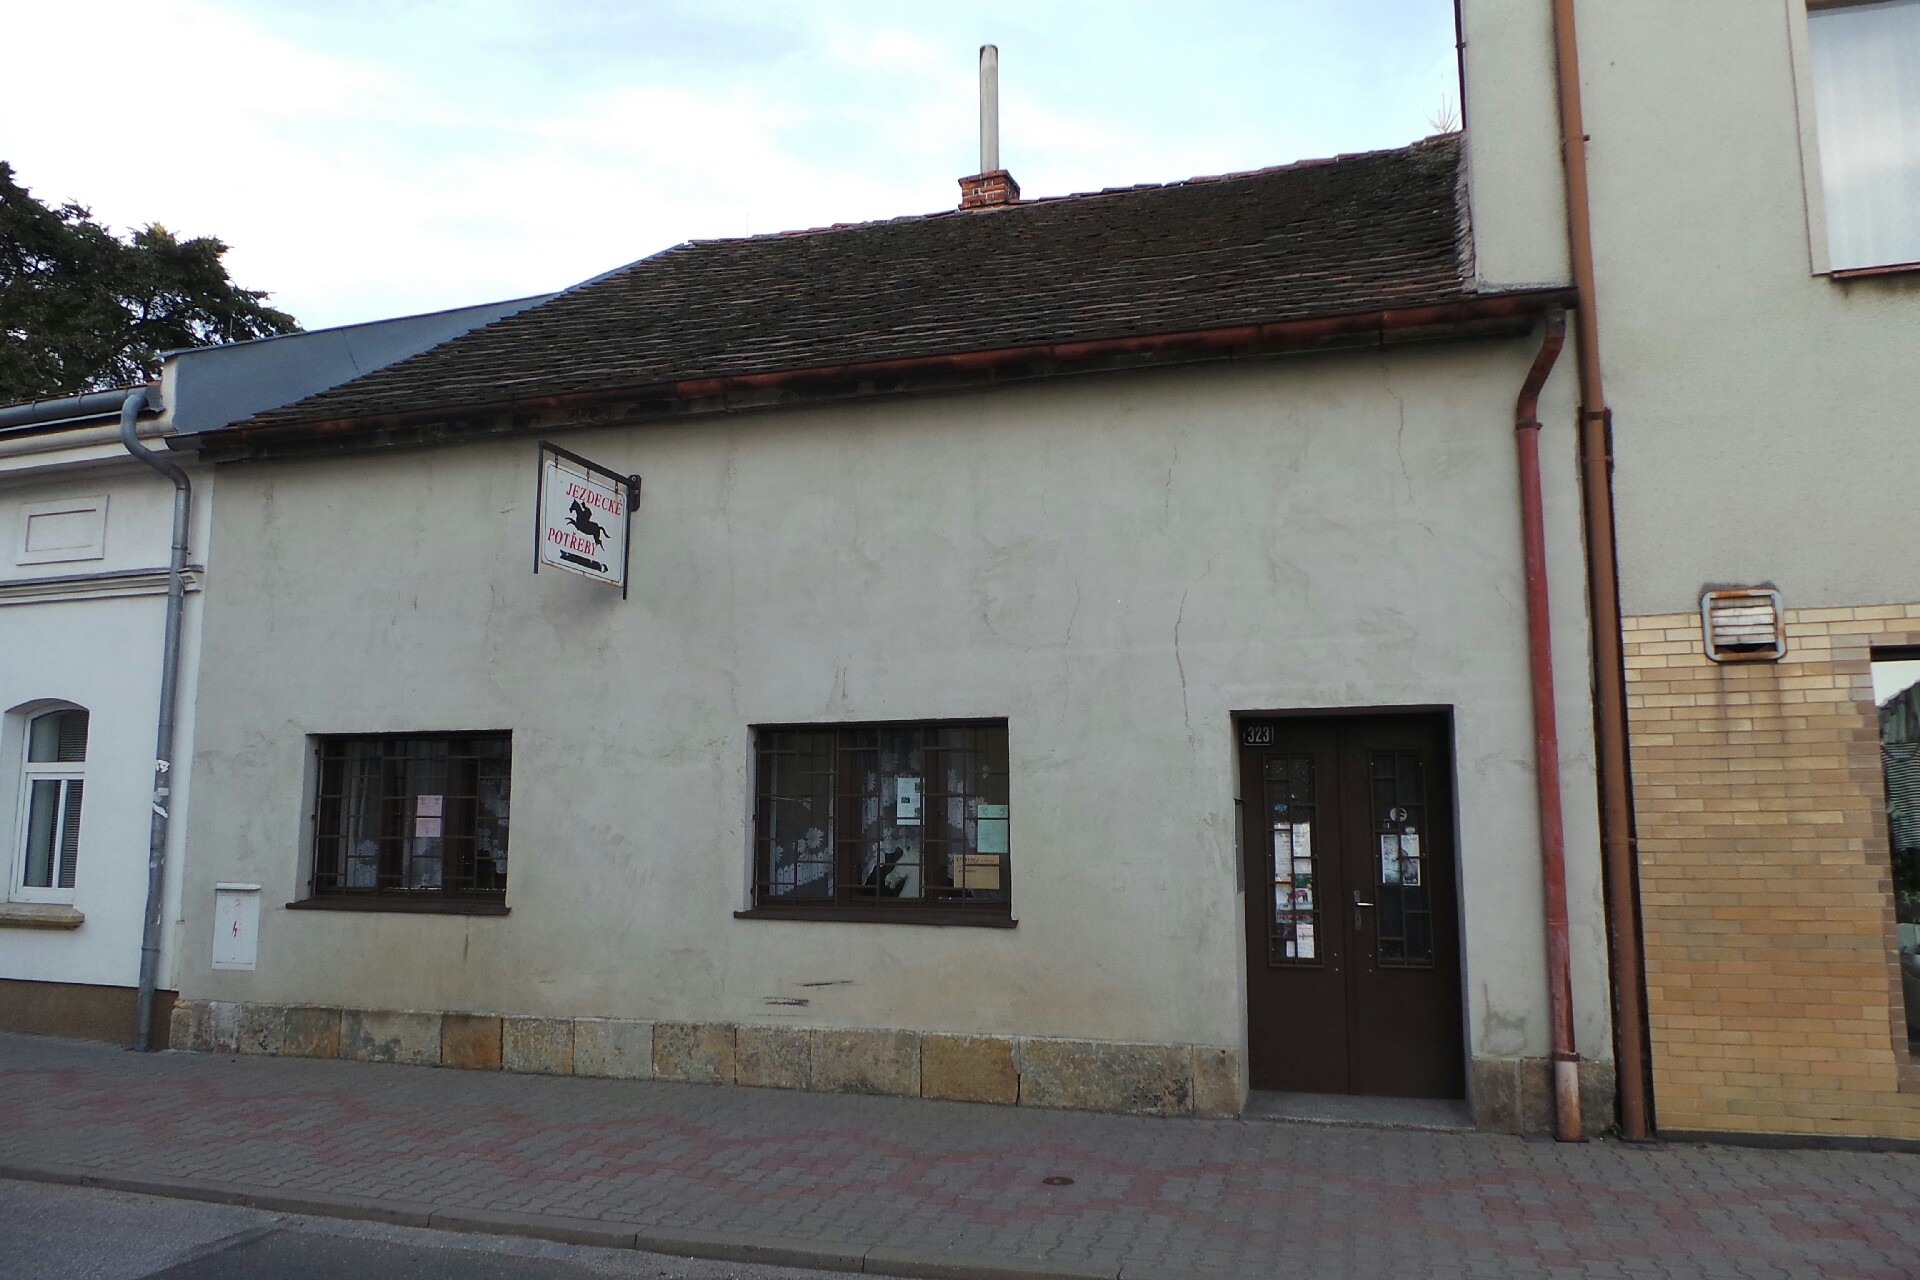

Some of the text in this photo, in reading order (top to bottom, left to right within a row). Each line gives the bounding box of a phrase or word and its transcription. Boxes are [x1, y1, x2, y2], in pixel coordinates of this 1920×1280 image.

[566, 482, 622, 516] JEZDECKÉ
[547, 527, 598, 556] POTŘEBY
[1247, 726, 1270, 742] 323
